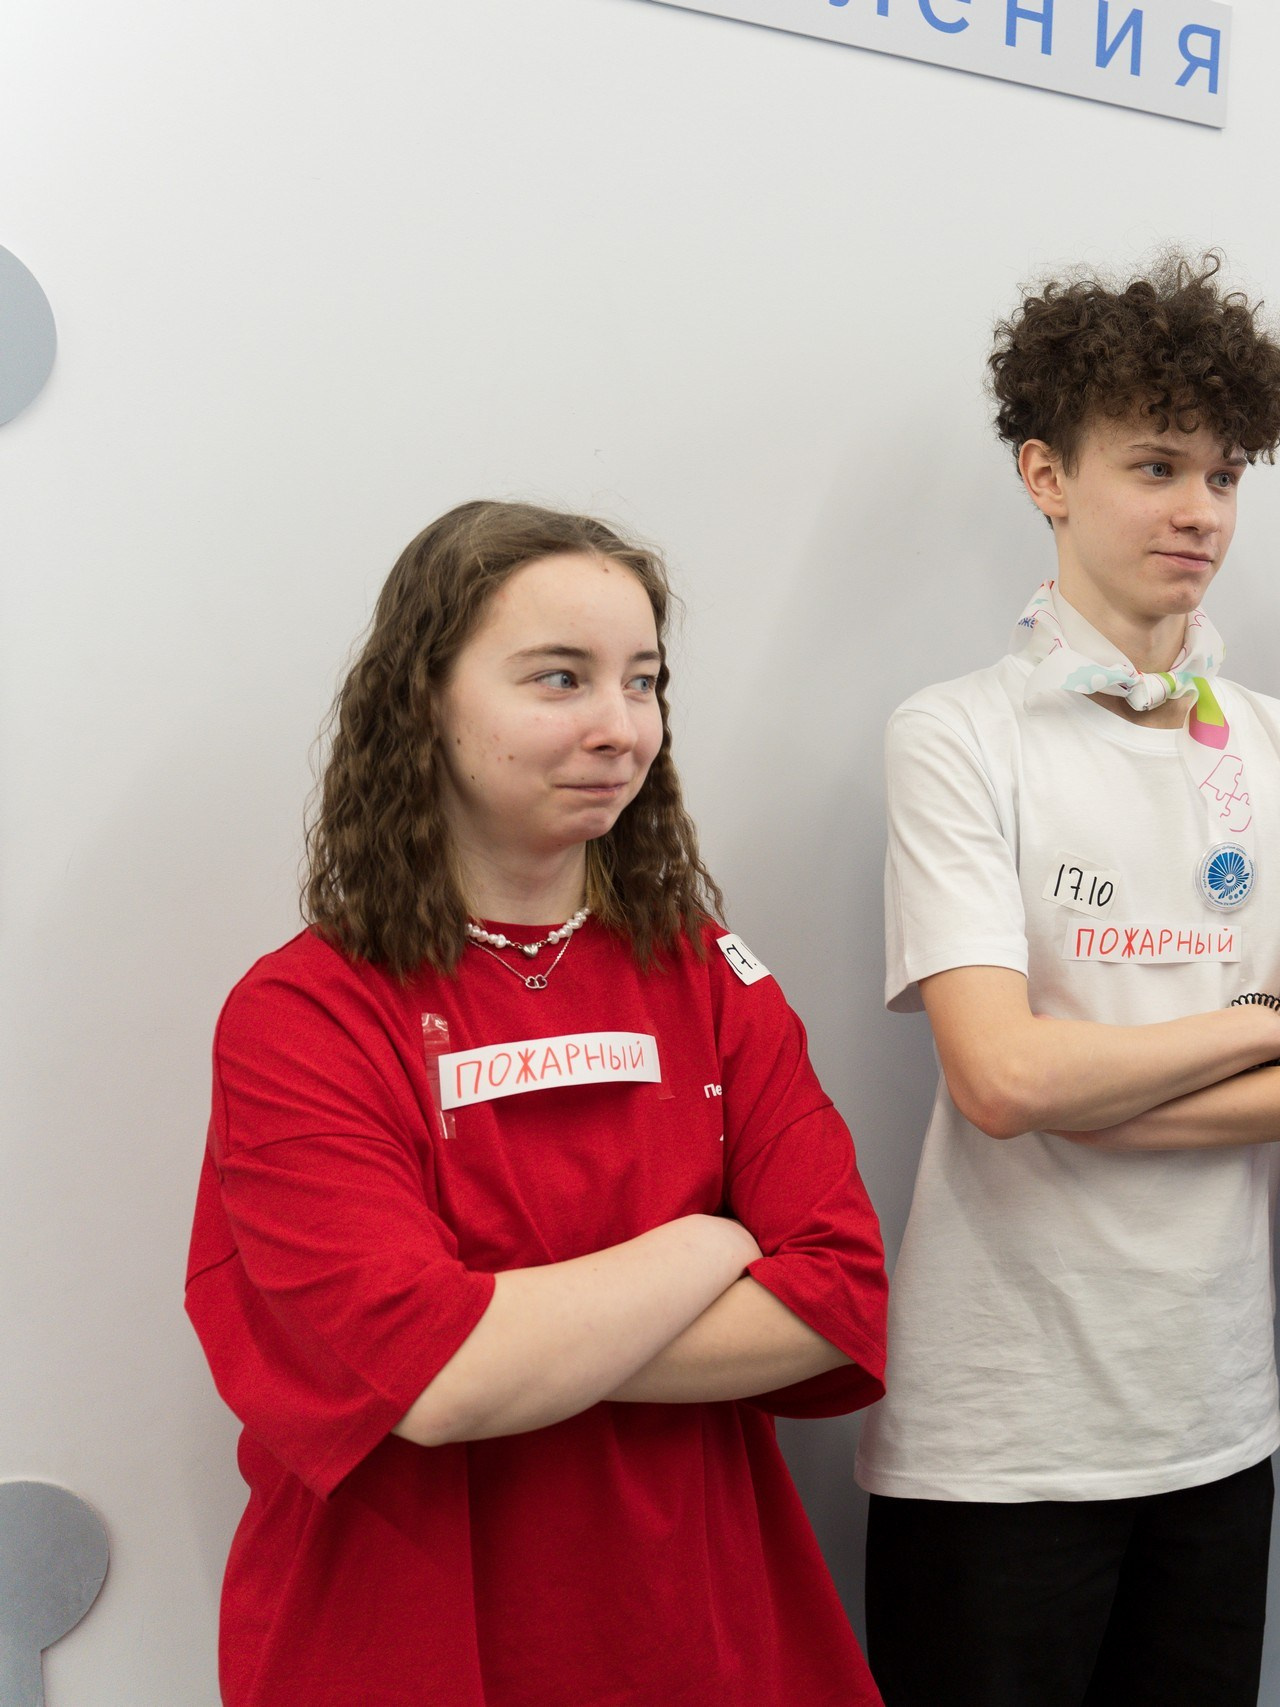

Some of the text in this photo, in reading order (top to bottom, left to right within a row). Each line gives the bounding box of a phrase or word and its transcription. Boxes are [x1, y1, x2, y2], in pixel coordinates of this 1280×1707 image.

[1054, 863, 1114, 907] 17.10
[1075, 927, 1234, 958] ПОЖАРНЫЙ
[455, 1040, 645, 1099] ПОЖАРНЫЙ
